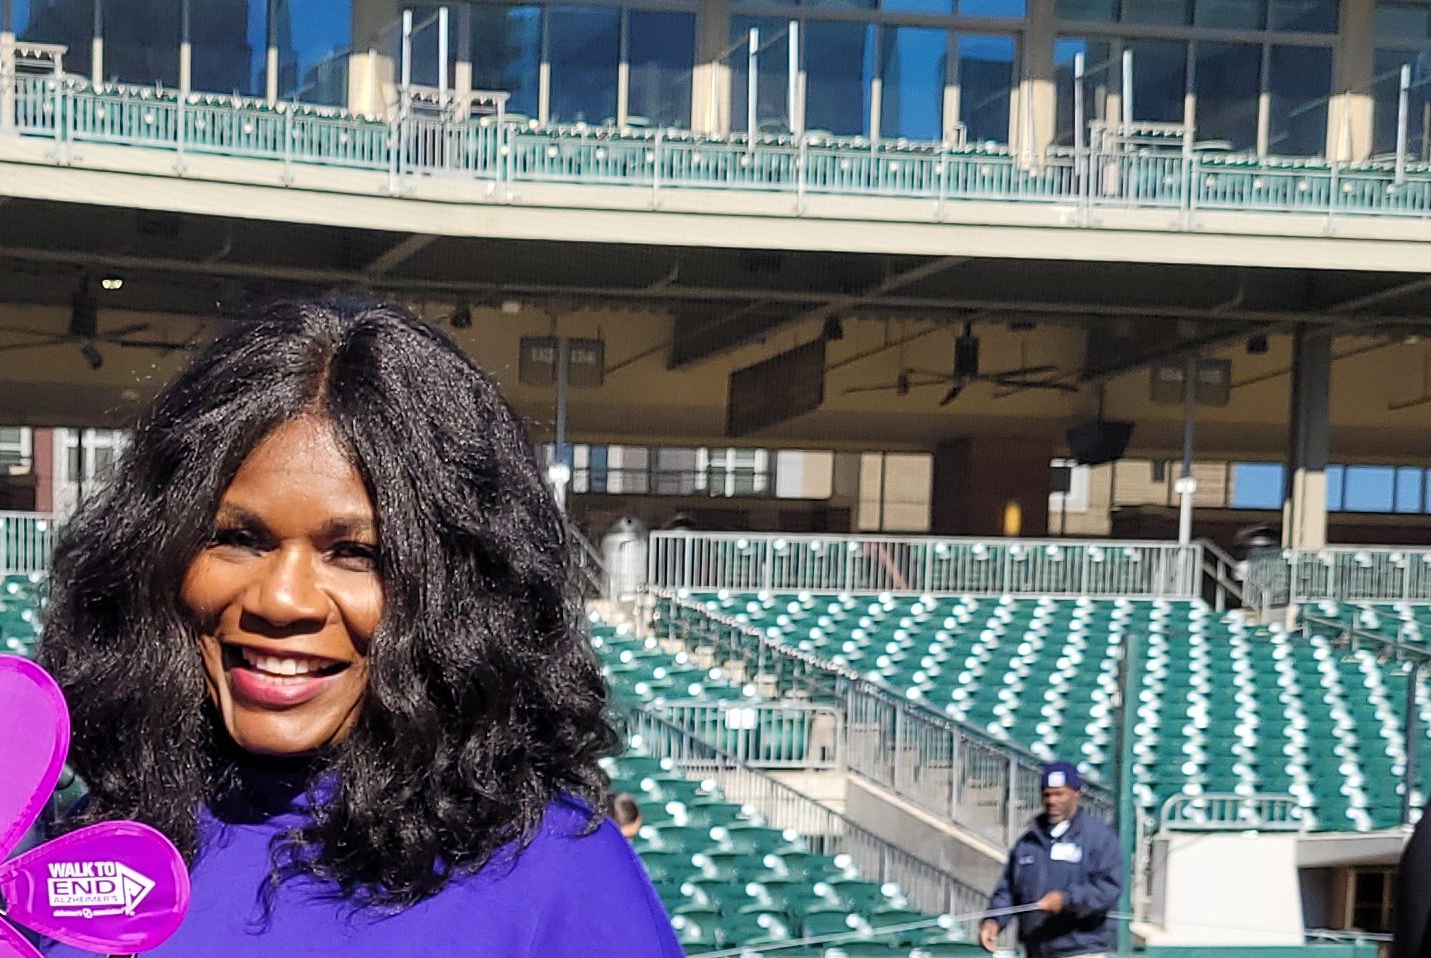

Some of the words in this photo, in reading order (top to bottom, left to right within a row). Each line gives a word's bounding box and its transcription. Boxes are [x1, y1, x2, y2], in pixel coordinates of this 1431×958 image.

[47, 862, 94, 878] WALK
[93, 861, 115, 877] TO
[53, 880, 116, 895] END
[53, 895, 119, 904] ALZHEIMER'S
